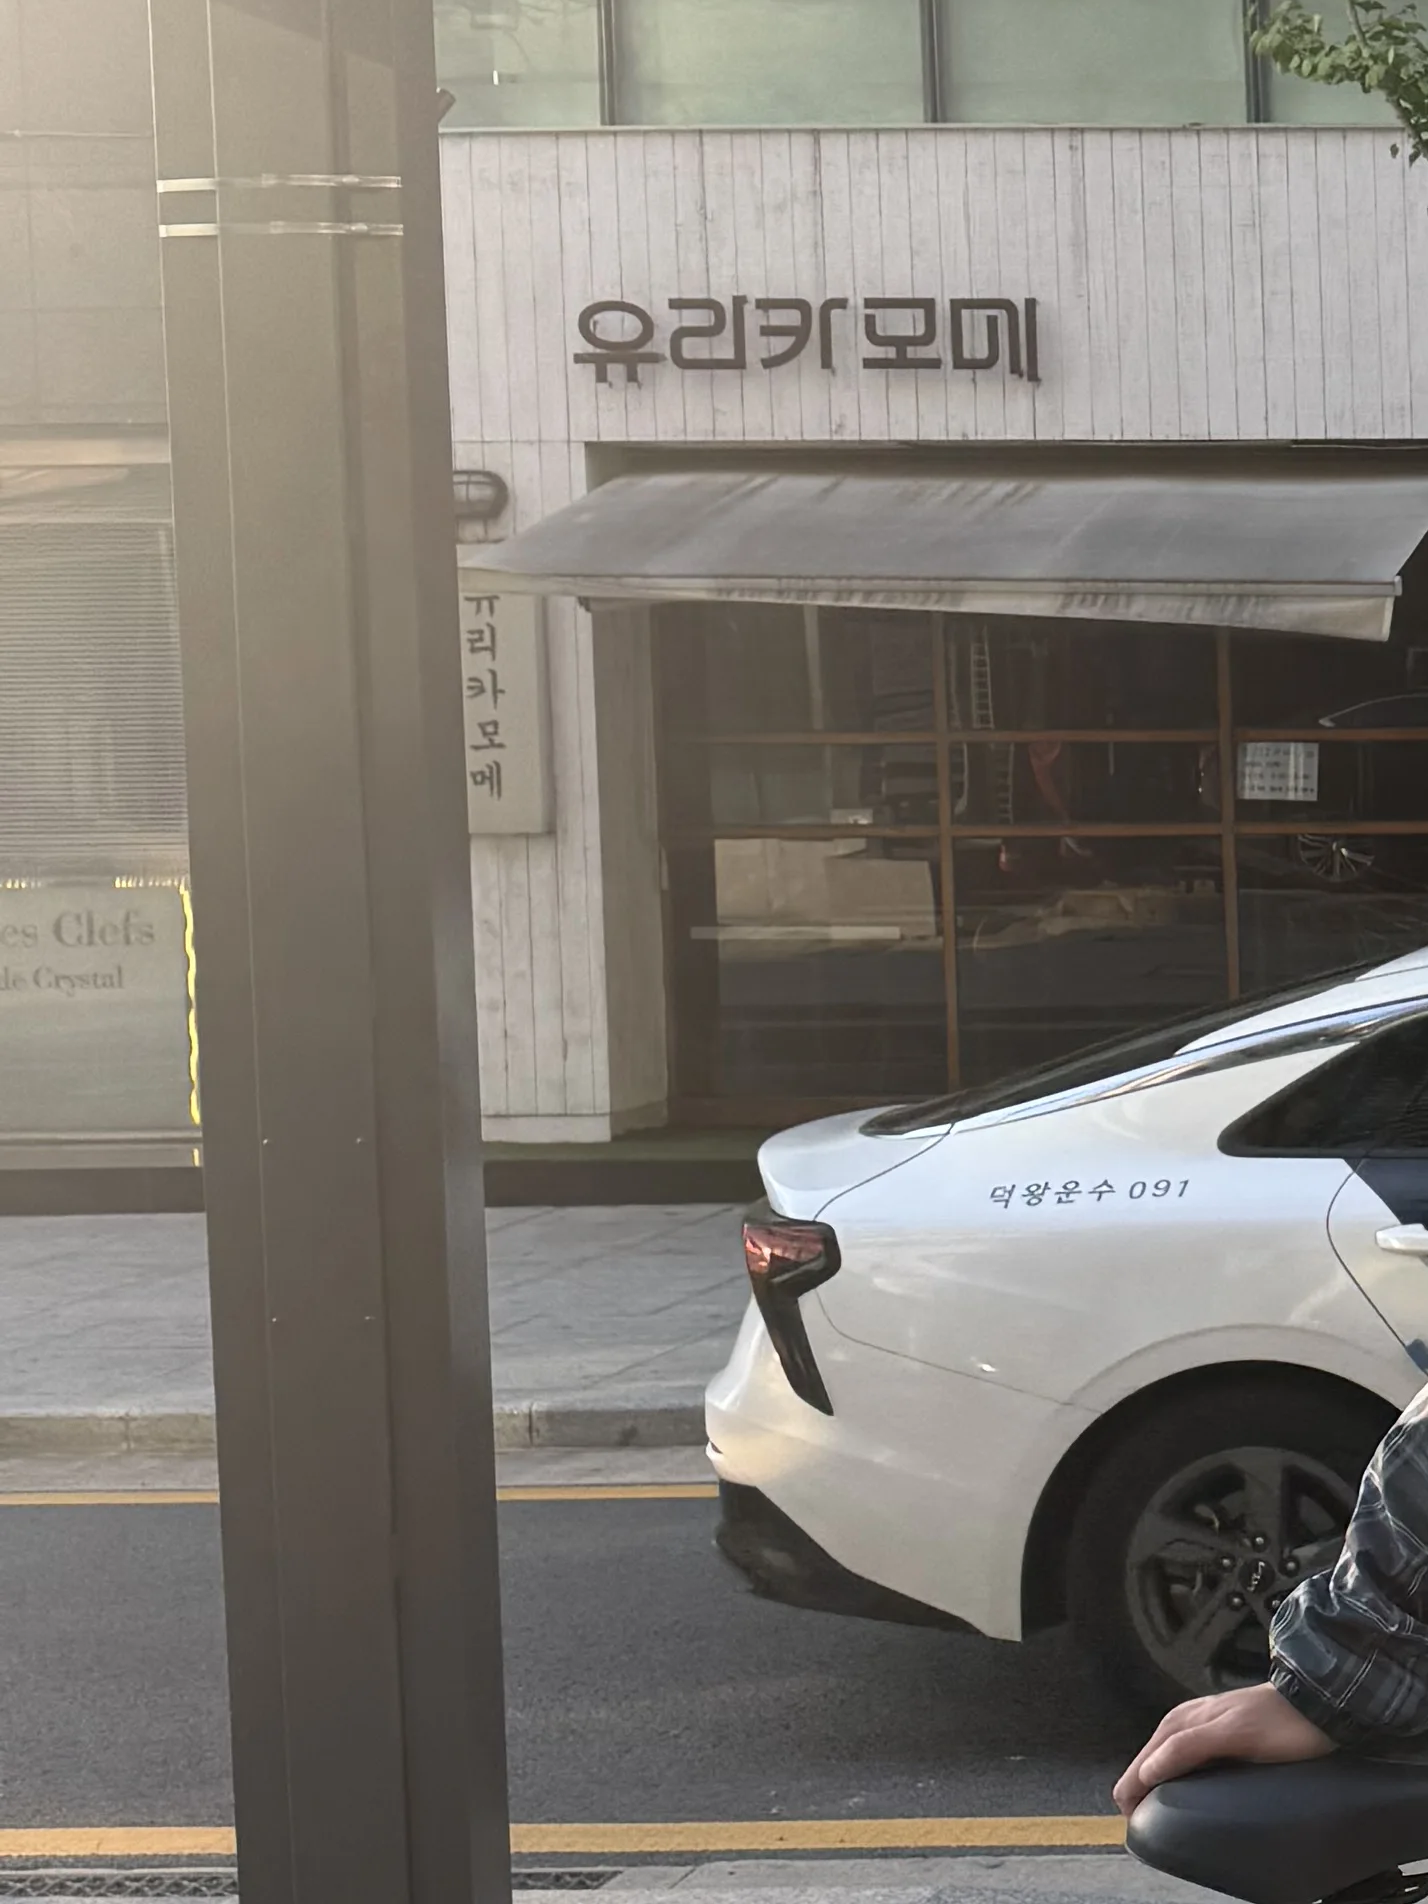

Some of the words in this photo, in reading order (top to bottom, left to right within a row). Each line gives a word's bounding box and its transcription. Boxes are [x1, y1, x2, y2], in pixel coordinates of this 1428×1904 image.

[573, 295, 1042, 384] 유리카모메
[52, 909, 156, 948] Clefs
[33, 964, 125, 997] Crystal
[1128, 1179, 1190, 1200] 091
